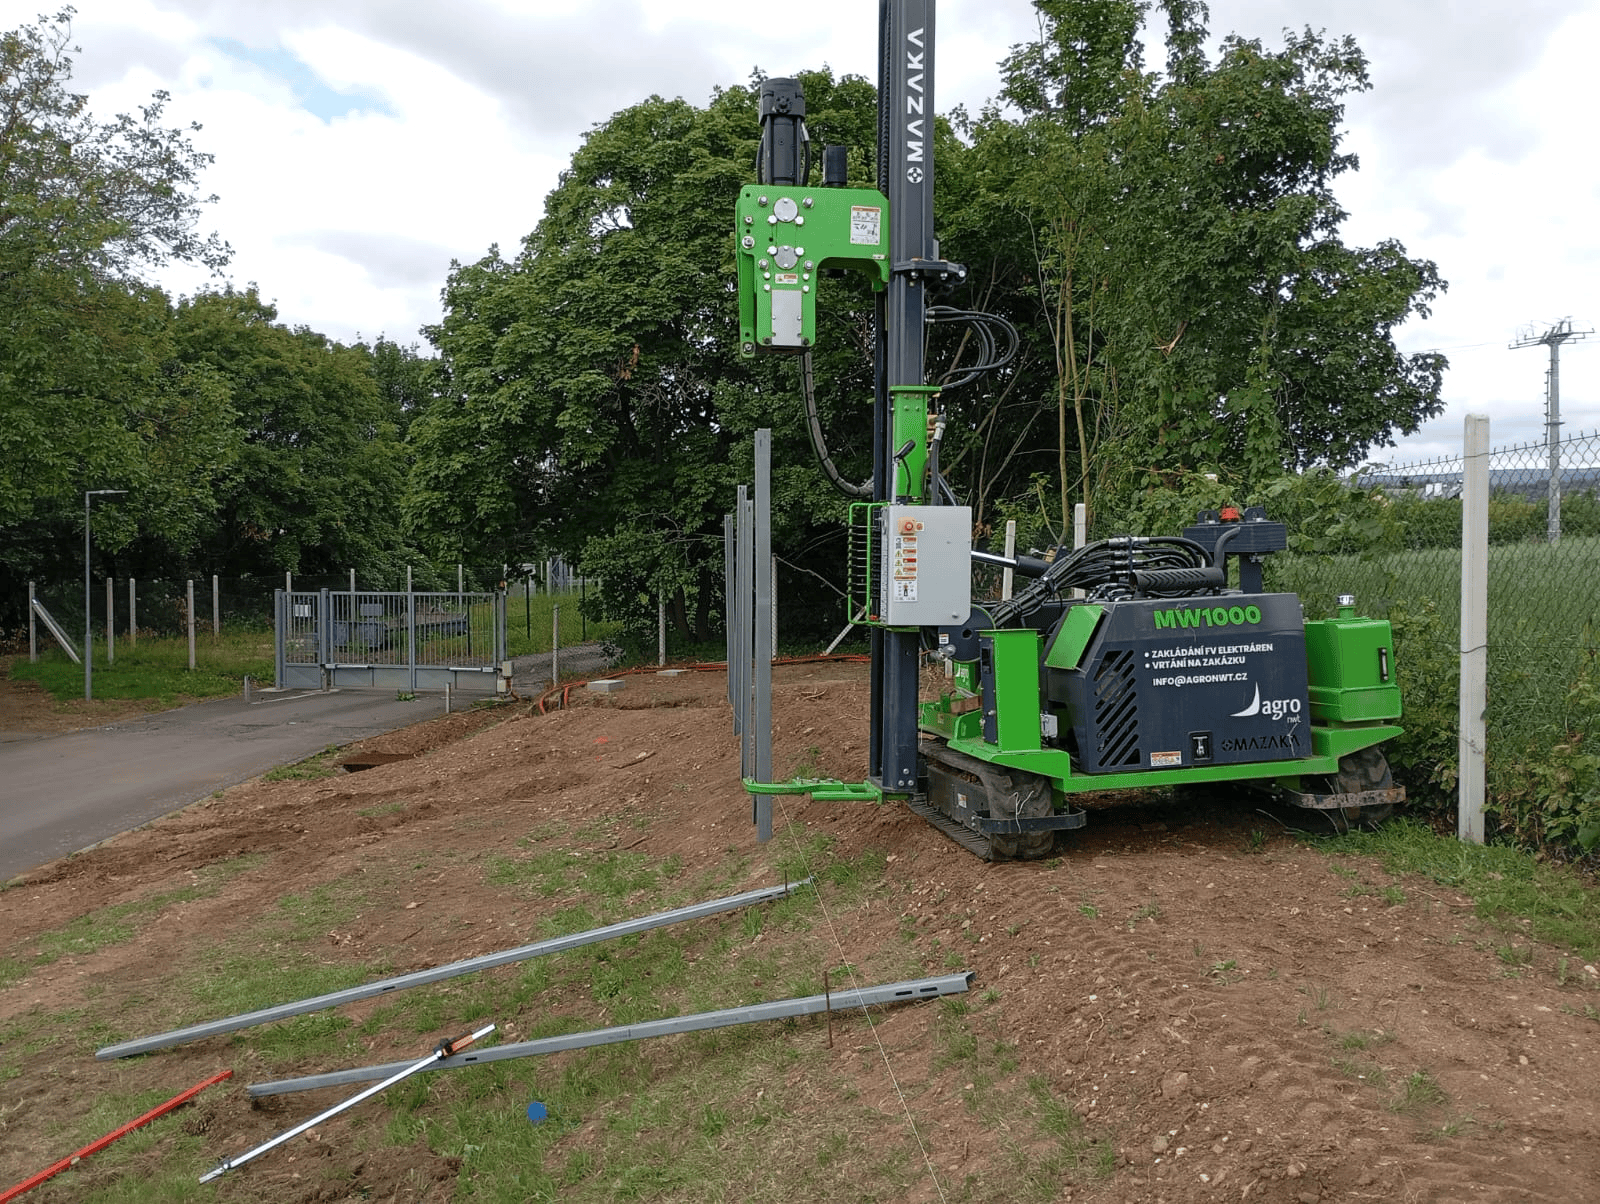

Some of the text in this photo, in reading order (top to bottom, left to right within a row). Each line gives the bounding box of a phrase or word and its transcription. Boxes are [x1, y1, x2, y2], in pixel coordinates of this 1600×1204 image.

[907, 28, 924, 162] MAZAKA
[1153, 604, 1262, 630] MW1000
[1151, 642, 1273, 658] ZAKLÁDÁNÍ FV ELEKTRÁREN
[1152, 656, 1246, 669] VRTÁNÍ NA ZAKÁZKU
[1152, 672, 1248, 687] INFO@AGRONWT.CZ
[1261, 699, 1301, 720] agro
[1287, 714, 1301, 723] nwt
